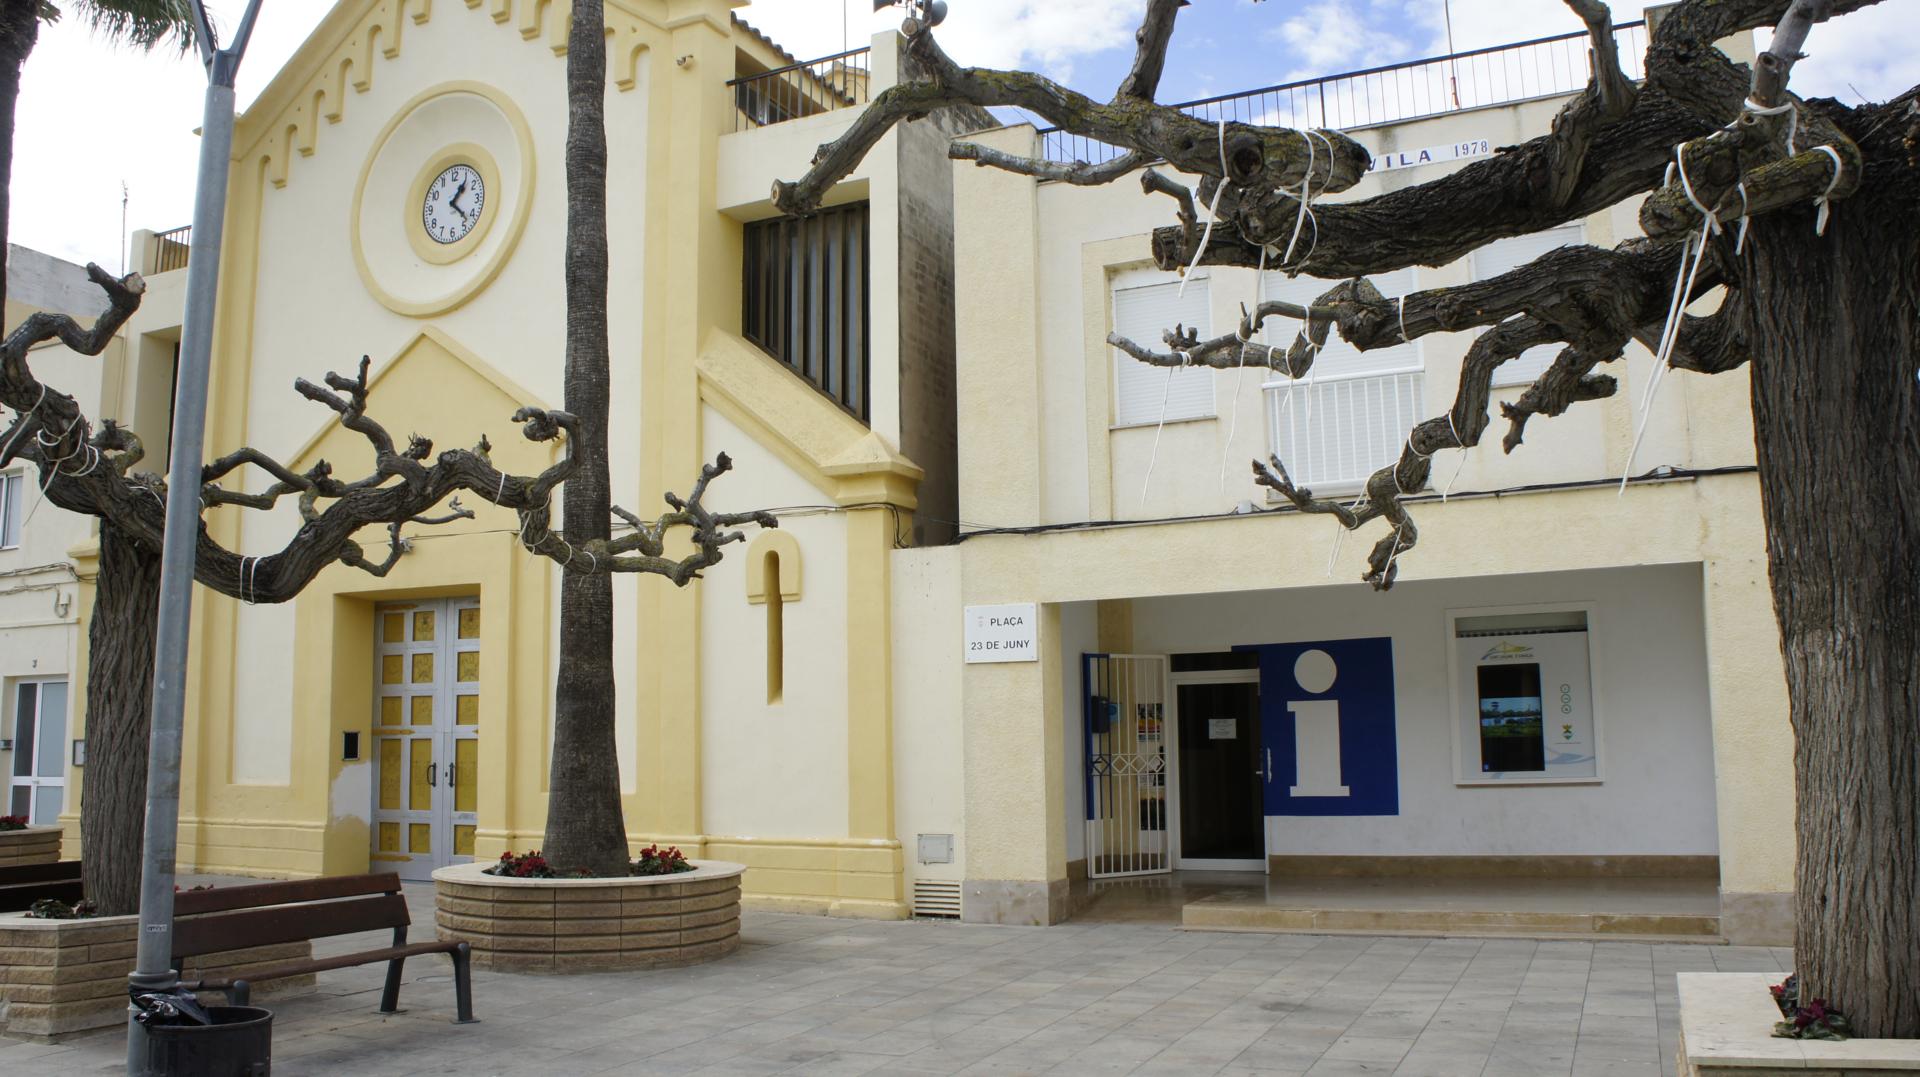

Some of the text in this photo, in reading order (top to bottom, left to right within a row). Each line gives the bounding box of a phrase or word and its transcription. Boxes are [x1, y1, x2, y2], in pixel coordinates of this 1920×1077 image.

[1455, 141, 1488, 157] 1978
[441, 176, 446, 188] 11
[451, 171, 459, 182] 12
[471, 180, 477, 190] 2
[432, 190, 440, 202] 10
[474, 193, 480, 204] 3
[428, 205, 434, 216] 9
[470, 208, 475, 218] 4
[431, 218, 437, 229] 8
[439, 226, 445, 236] 7
[449, 227, 456, 238] 6
[990, 617, 1023, 627] PLAÇA
[971, 640, 1030, 651] 23 DE JUNY
[1286, 649, 1351, 797] i
